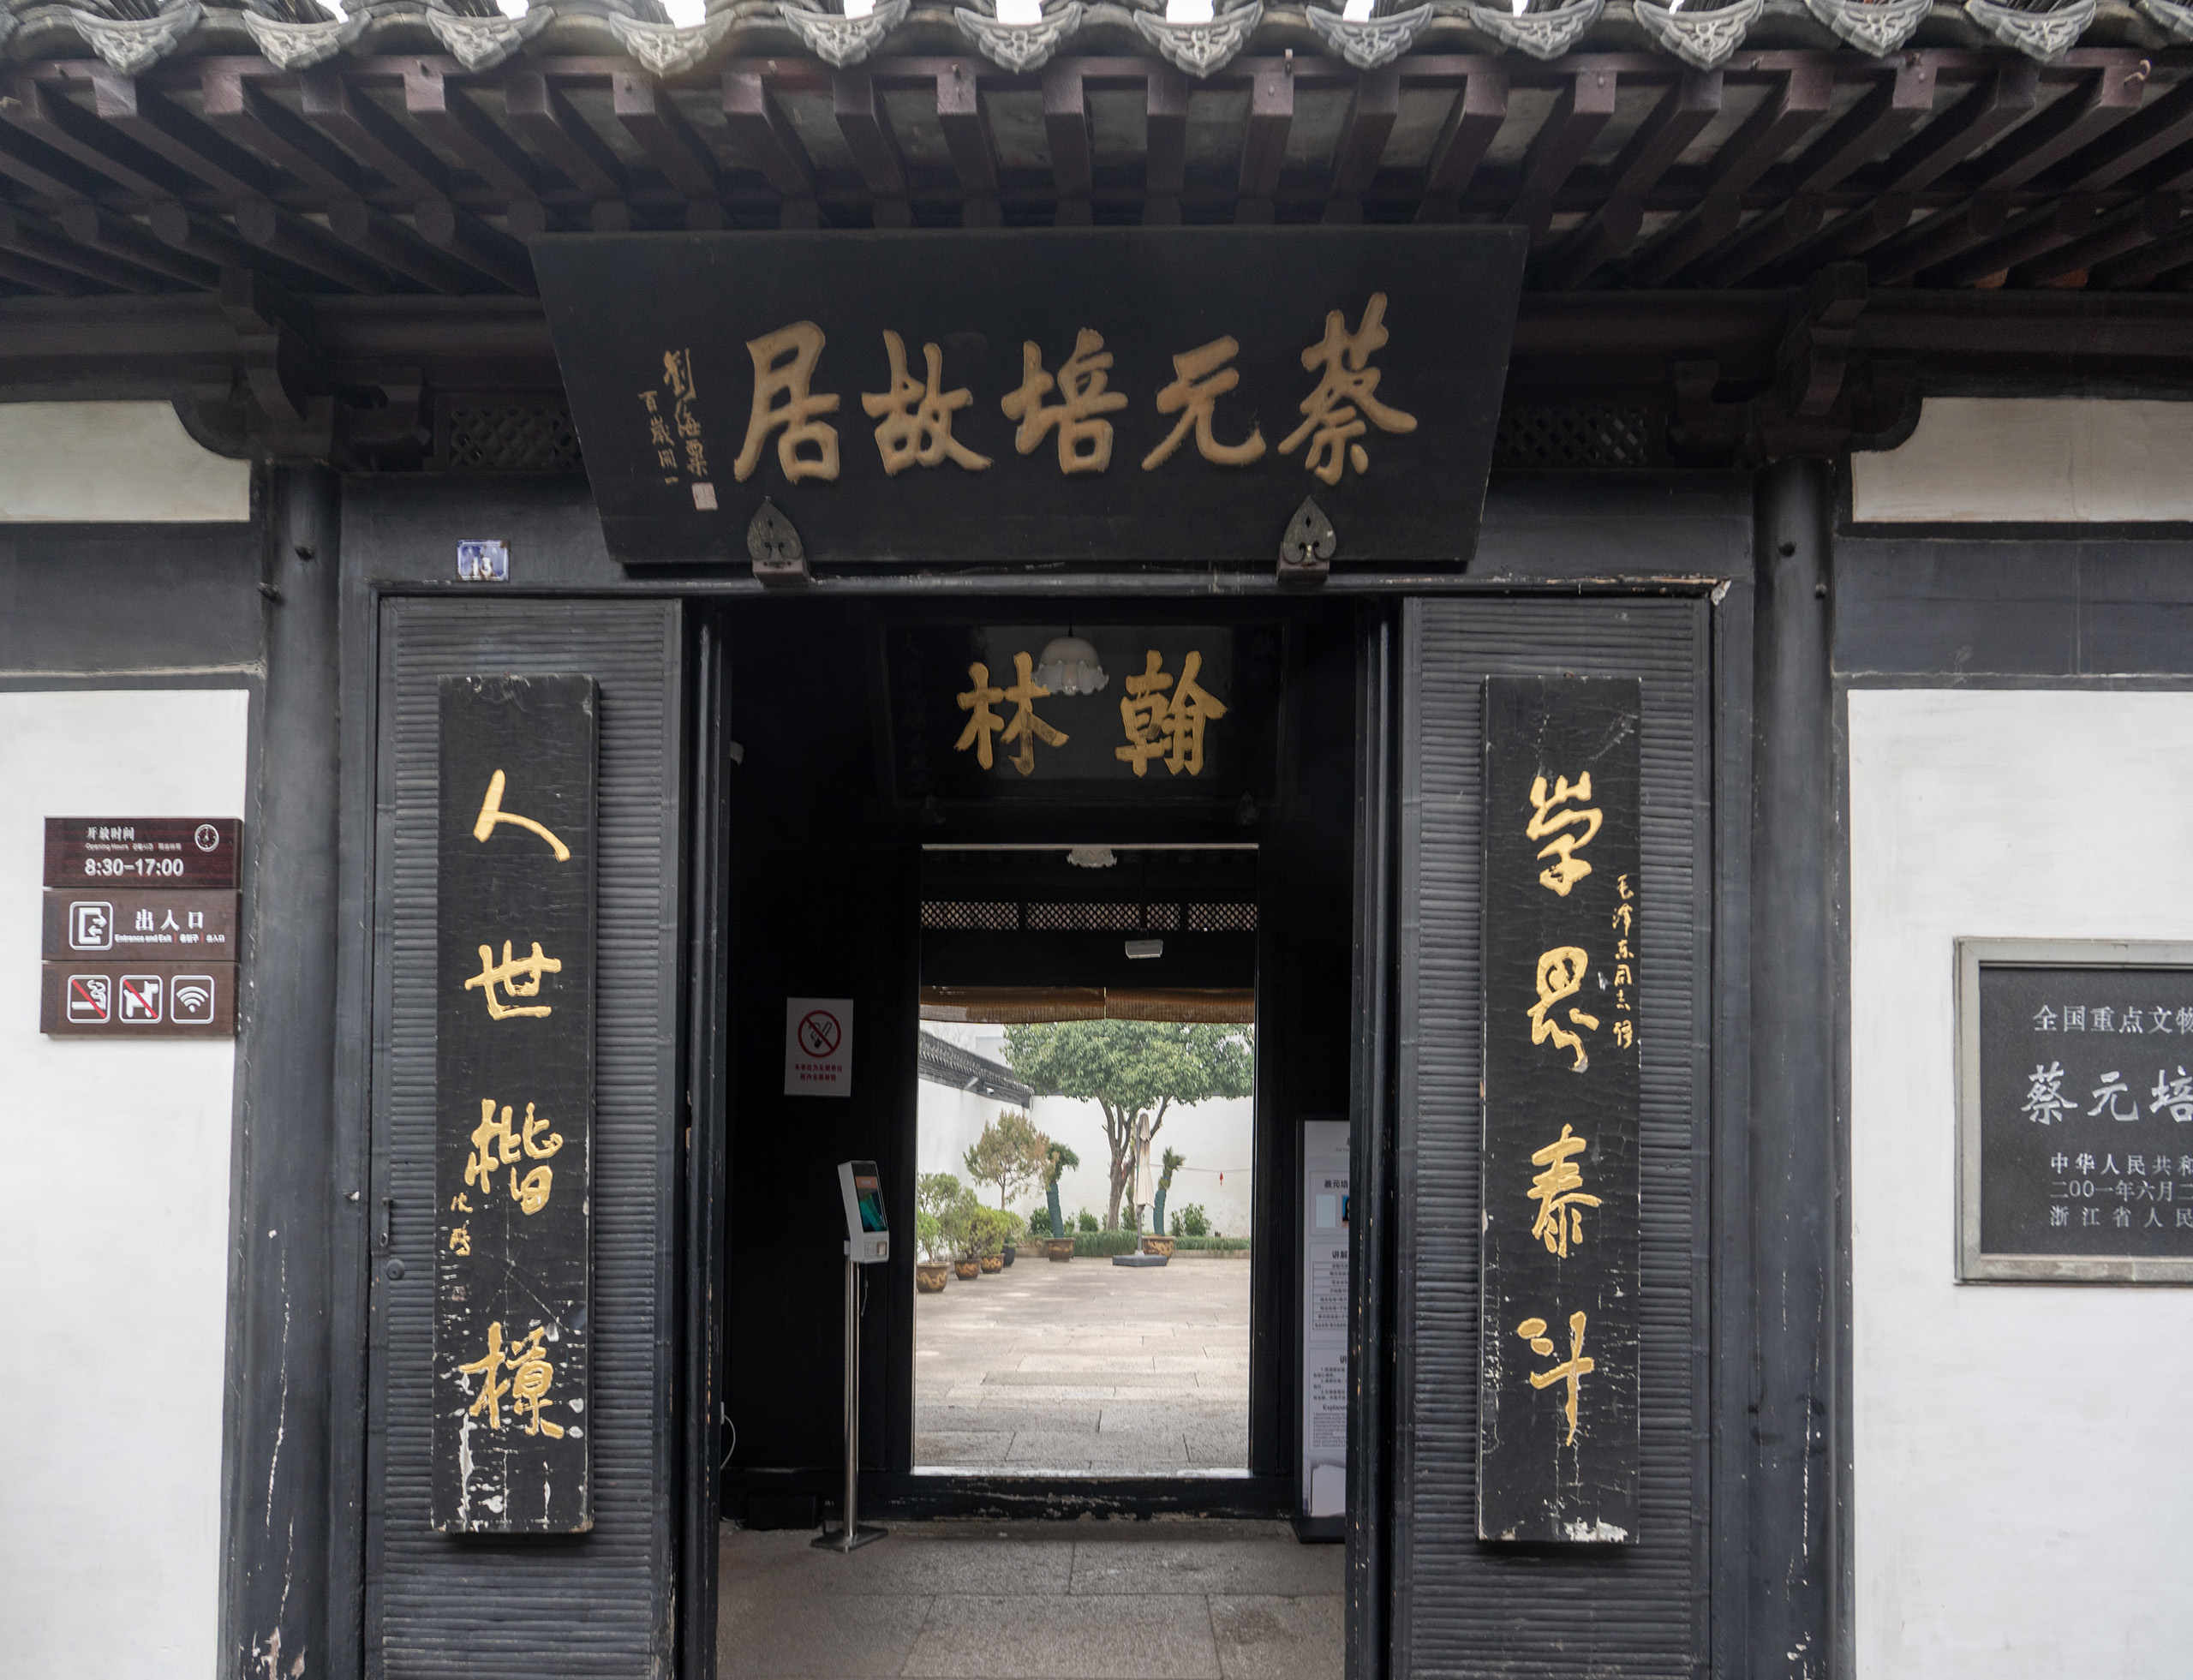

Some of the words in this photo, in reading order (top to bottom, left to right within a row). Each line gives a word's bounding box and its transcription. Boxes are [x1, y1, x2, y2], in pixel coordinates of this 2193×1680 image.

[734, 292, 1418, 485] 蔡元培故居
[953, 649, 1228, 777] 翰林
[87, 826, 134, 841] 开放时间
[85, 858, 184, 876] 8:30-17:00
[134, 908, 204, 932] 出入口
[2032, 1004, 2193, 1034] 全国重点文物
[458, 769, 571, 1440] 人世楷模
[2020, 1061, 2193, 1126] 蔡元培
[2049, 1205, 2193, 1229] 浙江省人民
